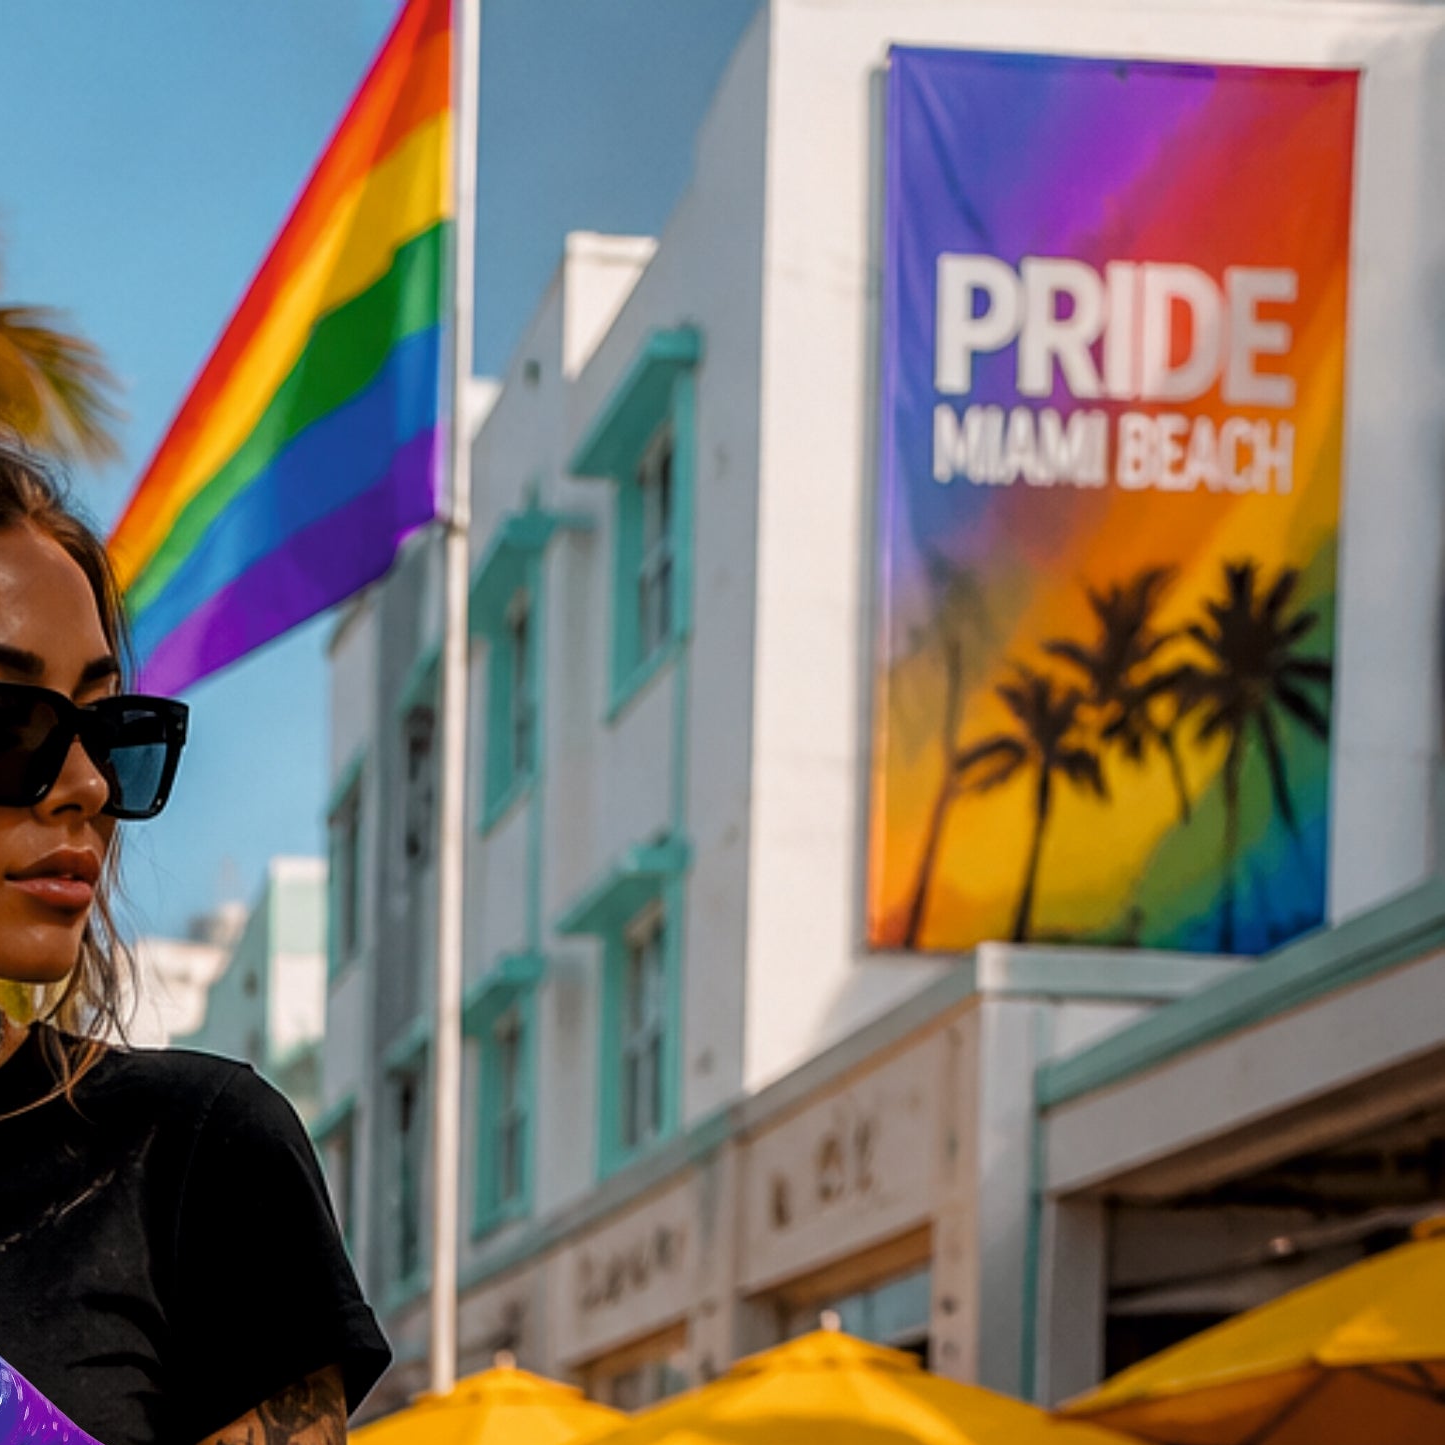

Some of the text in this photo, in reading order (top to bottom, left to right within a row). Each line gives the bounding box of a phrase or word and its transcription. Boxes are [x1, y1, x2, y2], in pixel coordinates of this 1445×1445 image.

[934, 251, 1298, 409] PRIDE
[933, 404, 1296, 495] MIAMI BEACH
